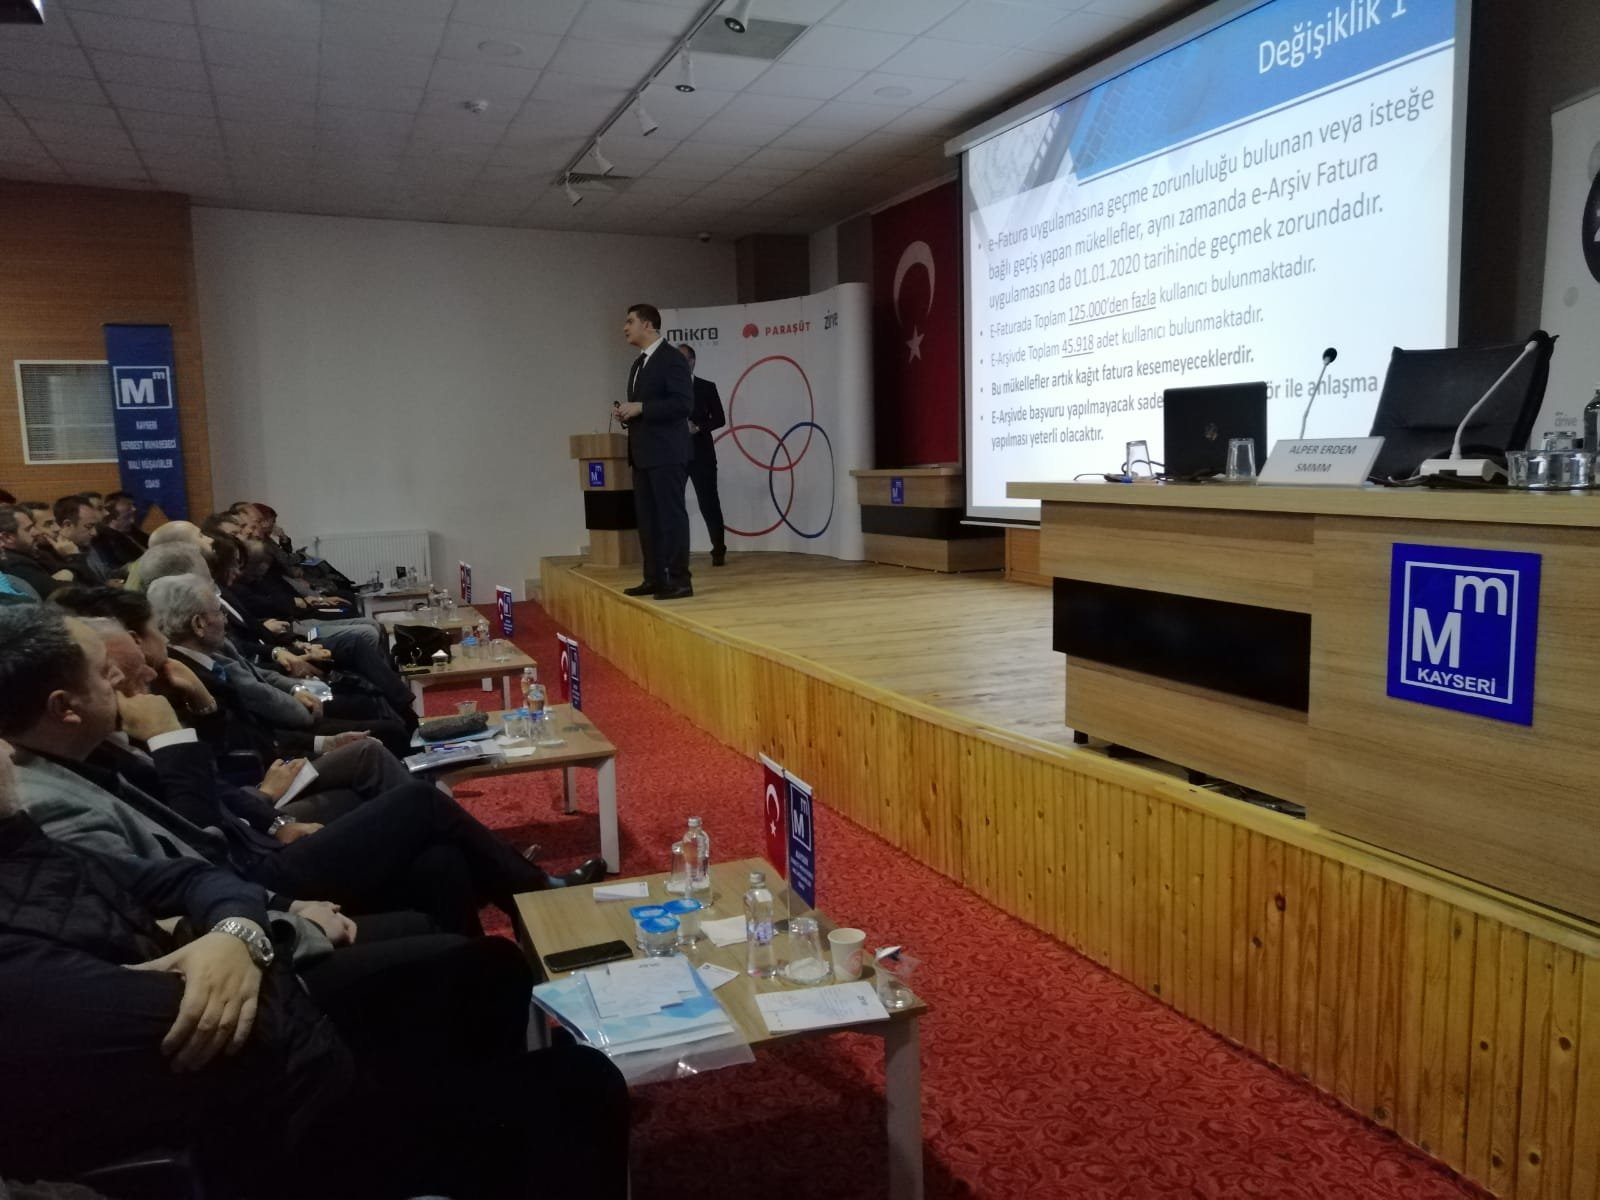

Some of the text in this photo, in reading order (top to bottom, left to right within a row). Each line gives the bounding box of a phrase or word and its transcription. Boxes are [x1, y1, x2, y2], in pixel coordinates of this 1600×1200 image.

[1259, 0, 1381, 74] Değişiklik
[988, 86, 1435, 252] e-Fatura uygulamasına geçme zorunluluğu bulunan veya isteğe
[988, 151, 1379, 281] bağlı geçiş yapan mükellefler, aynı zamanda e-Arşiv Fatura
[988, 192, 1384, 311] uygulamasına da 01.01.2020 tarihinde geçmek zorundadır.
[989, 318, 1033, 339] E-Faturada
[1034, 309, 1067, 332] Toplam
[1131, 289, 1157, 309] fazla
[1159, 280, 1208, 304] kullanıcı
[1211, 255, 1317, 293] bulunmaktadır.
[765, 320, 811, 337] PARAŞÜT
[990, 304, 1265, 368] E-Arşivde Toplam 45.918 adet kullanıcı bulunmaktadır.
[991, 345, 1255, 396] Bu mükellefler artık kağıt fatura kesemeyeceklerdir.
[991, 405, 1028, 427] E-Arşivde
[1029, 401, 1066, 424] başvuru
[1067, 394, 1136, 421] yapılmayacak
[1137, 391, 1165, 411] sade
[1285, 378, 1304, 399] ile
[1308, 373, 1379, 400] anlaşma
[991, 424, 1105, 452] yapılması yeterli olacaktır.
[1289, 444, 1357, 455] ALPER ERDEM
[1296, 463, 1332, 473] SMMM
[1417, 667, 1496, 695] KAYSERİ
